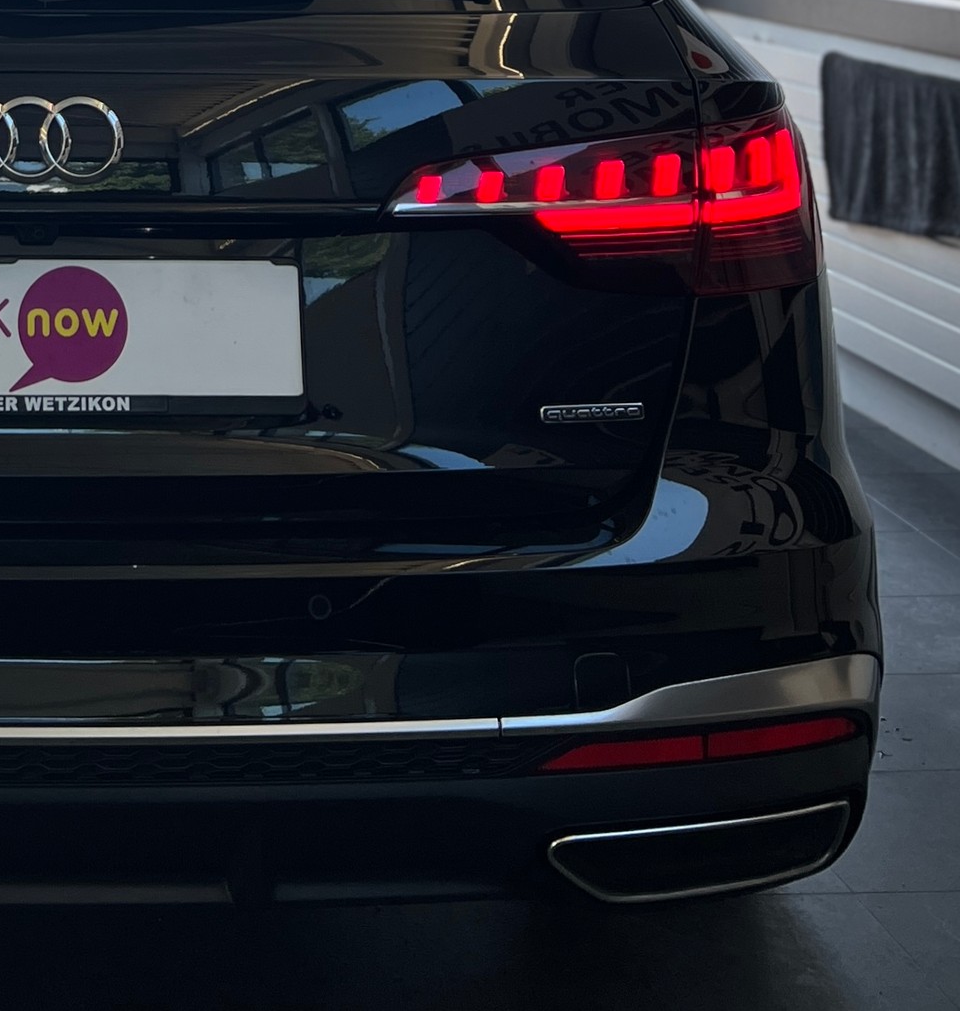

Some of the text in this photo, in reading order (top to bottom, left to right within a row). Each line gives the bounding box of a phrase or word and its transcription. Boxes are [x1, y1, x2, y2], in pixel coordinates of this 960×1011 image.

[25, 307, 120, 338] now
[24, 395, 131, 413] WETZIKON
[545, 406, 641, 421] quattro
